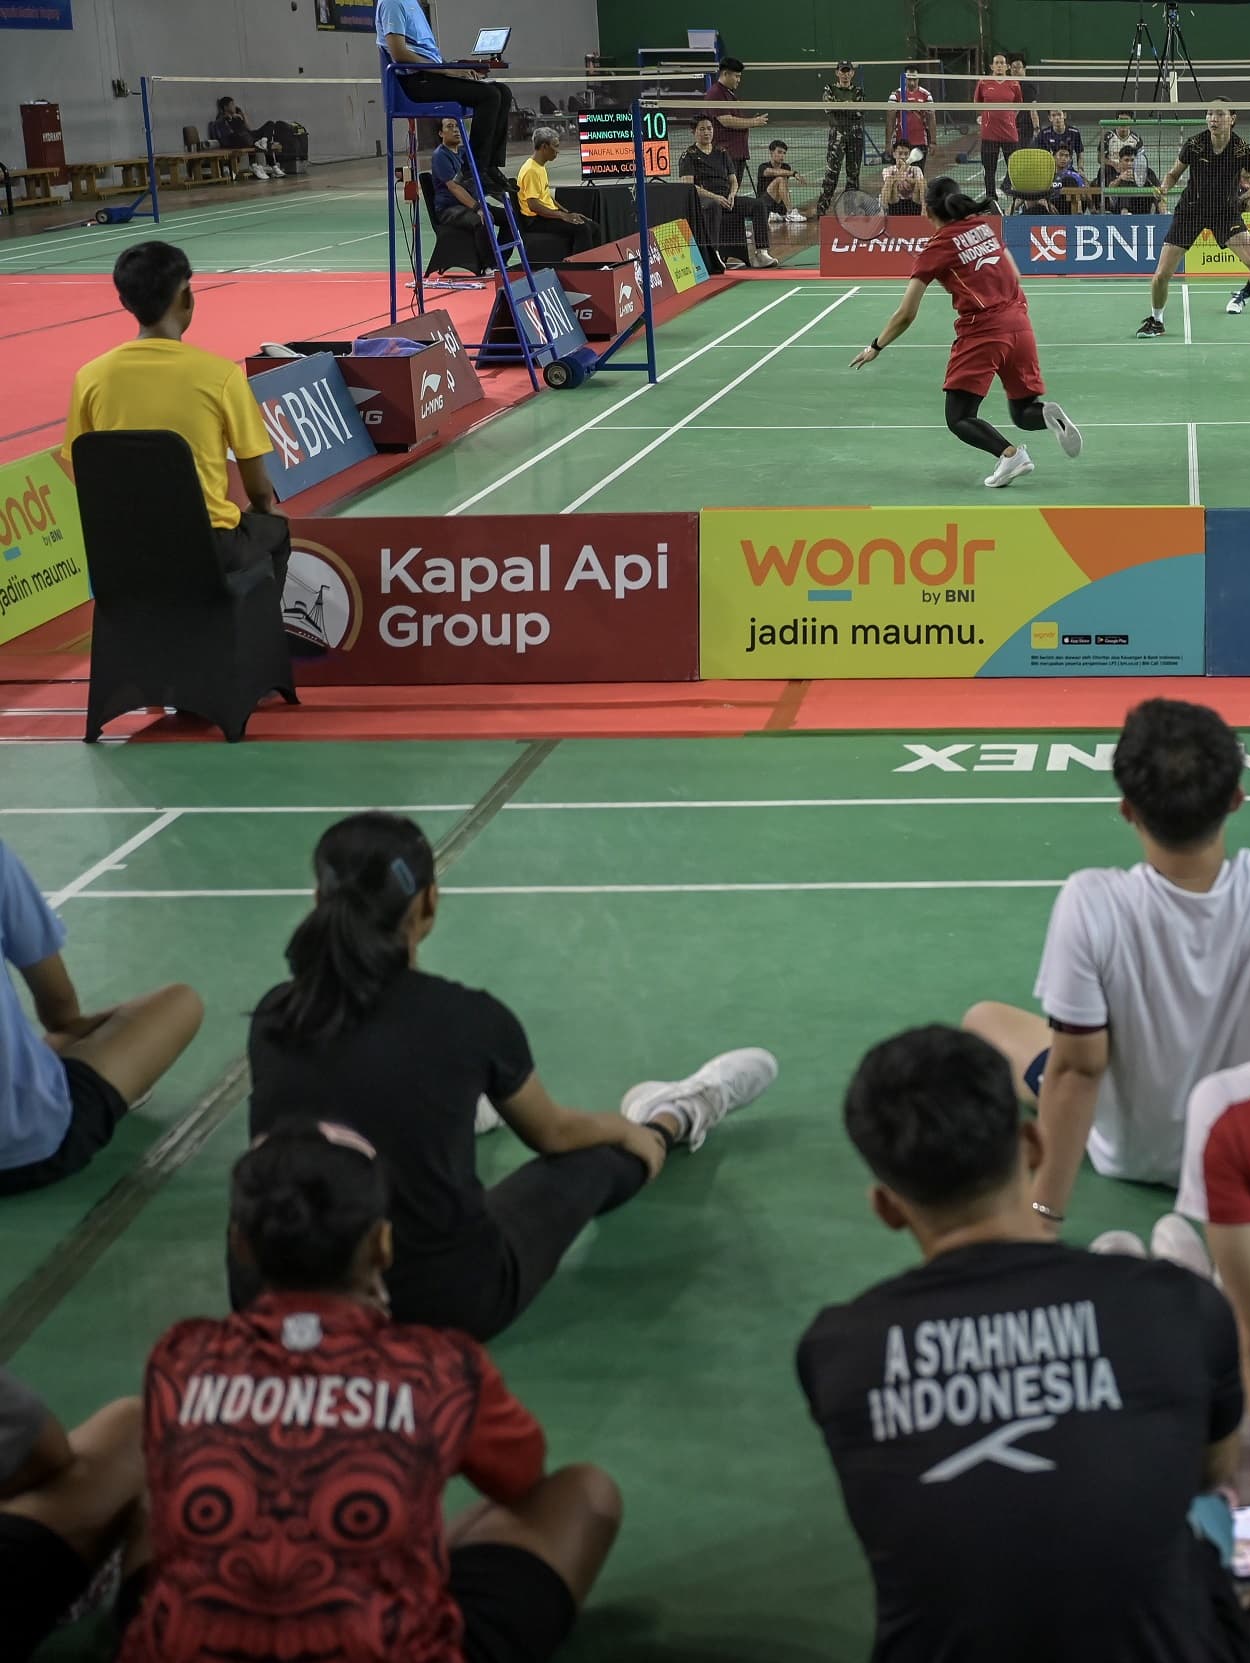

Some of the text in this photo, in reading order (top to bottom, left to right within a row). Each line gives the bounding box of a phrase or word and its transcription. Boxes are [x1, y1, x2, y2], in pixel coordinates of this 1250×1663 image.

[588, 130, 629, 139] HANINGTYAS
[643, 112, 667, 139] 10
[645, 147, 668, 171] 16
[1074, 225, 1157, 263] BNI
[1201, 252, 1235, 266] jadiin
[282, 377, 353, 458] BNI
[421, 395, 444, 420] LI-NING
[0, 475, 56, 546] ondr
[380, 542, 669, 602] Kapal Api
[740, 523, 996, 587] wondr
[32, 557, 81, 592] maumu.
[922, 589, 975, 605] by BNI
[378, 604, 551, 654] Group
[745, 617, 985, 653] jadiin maumu.
[884, 1300, 1101, 1385] A SYAHNAWI
[178, 1373, 416, 1435] INDONESIA
[867, 1357, 1123, 1442] INDONESIA
